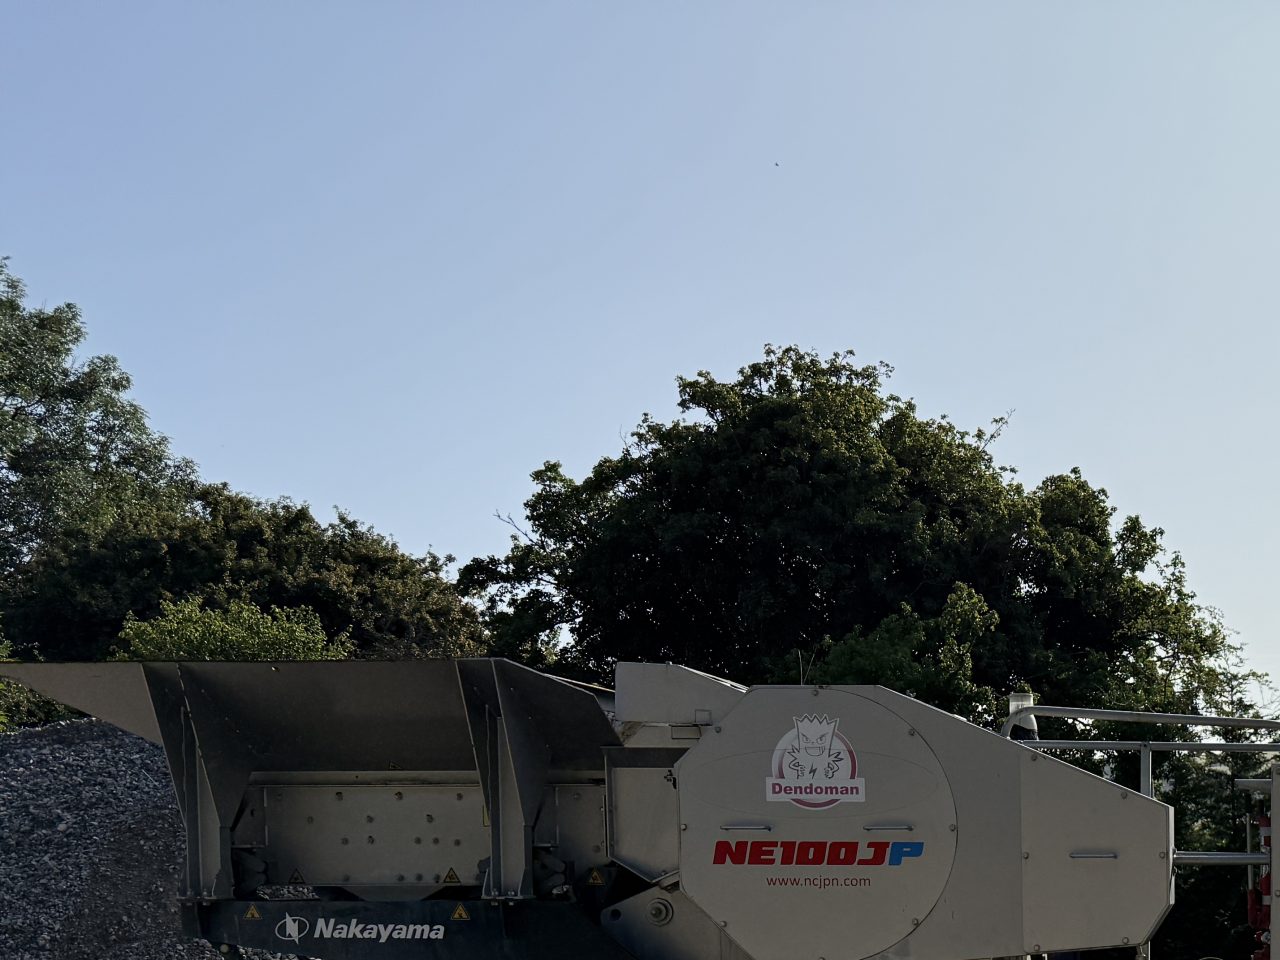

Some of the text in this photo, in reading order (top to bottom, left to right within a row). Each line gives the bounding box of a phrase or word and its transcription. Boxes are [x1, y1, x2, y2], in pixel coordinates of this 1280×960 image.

[771, 782, 860, 796] Dendoman
[712, 840, 925, 866] NE100JP
[766, 875, 871, 889] www.ncjpn.com
[313, 917, 445, 943] Nakayama
